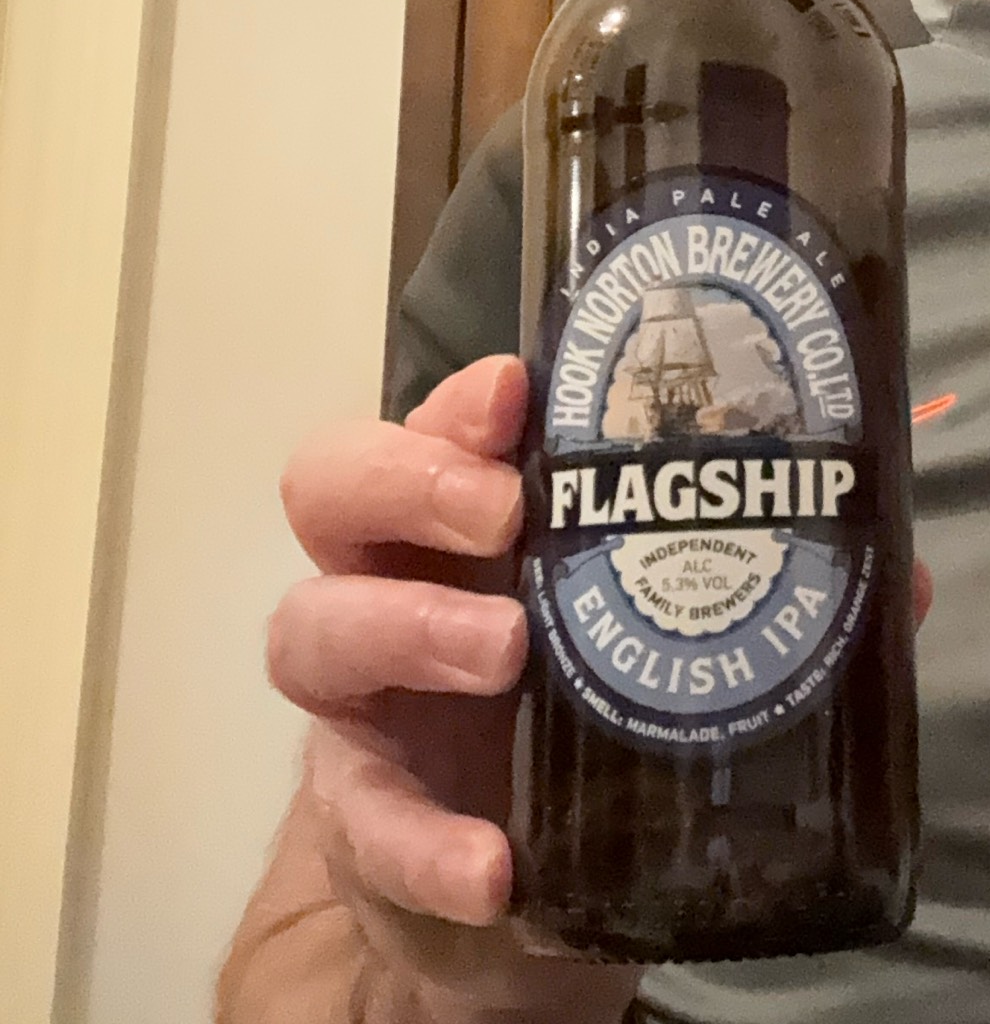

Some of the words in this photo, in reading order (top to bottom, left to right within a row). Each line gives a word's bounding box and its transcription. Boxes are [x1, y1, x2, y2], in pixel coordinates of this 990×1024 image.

[672, 189, 772, 218] PALE
[796, 231, 847, 289] ALE
[687, 225, 830, 332] BREWERY
[573, 230, 683, 346] NORTON
[552, 341, 605, 428] HOOK
[550, 459, 856, 529] FLAGSHIP
[635, 576, 685, 618] FAMILY
[689, 572, 761, 620] BREWERS
[639, 538, 758, 569] INDEPENDENT
[682, 559, 712, 573] ALC
[702, 576, 732, 590] VOL
[548, 628, 576, 678] BRONZE
[581, 687, 624, 726] SMELL:
[728, 710, 769, 736] FRUIT
[785, 669, 827, 707] TASTE:
[572, 585, 756, 695] ENGLISH
[761, 585, 828, 656] IPA
